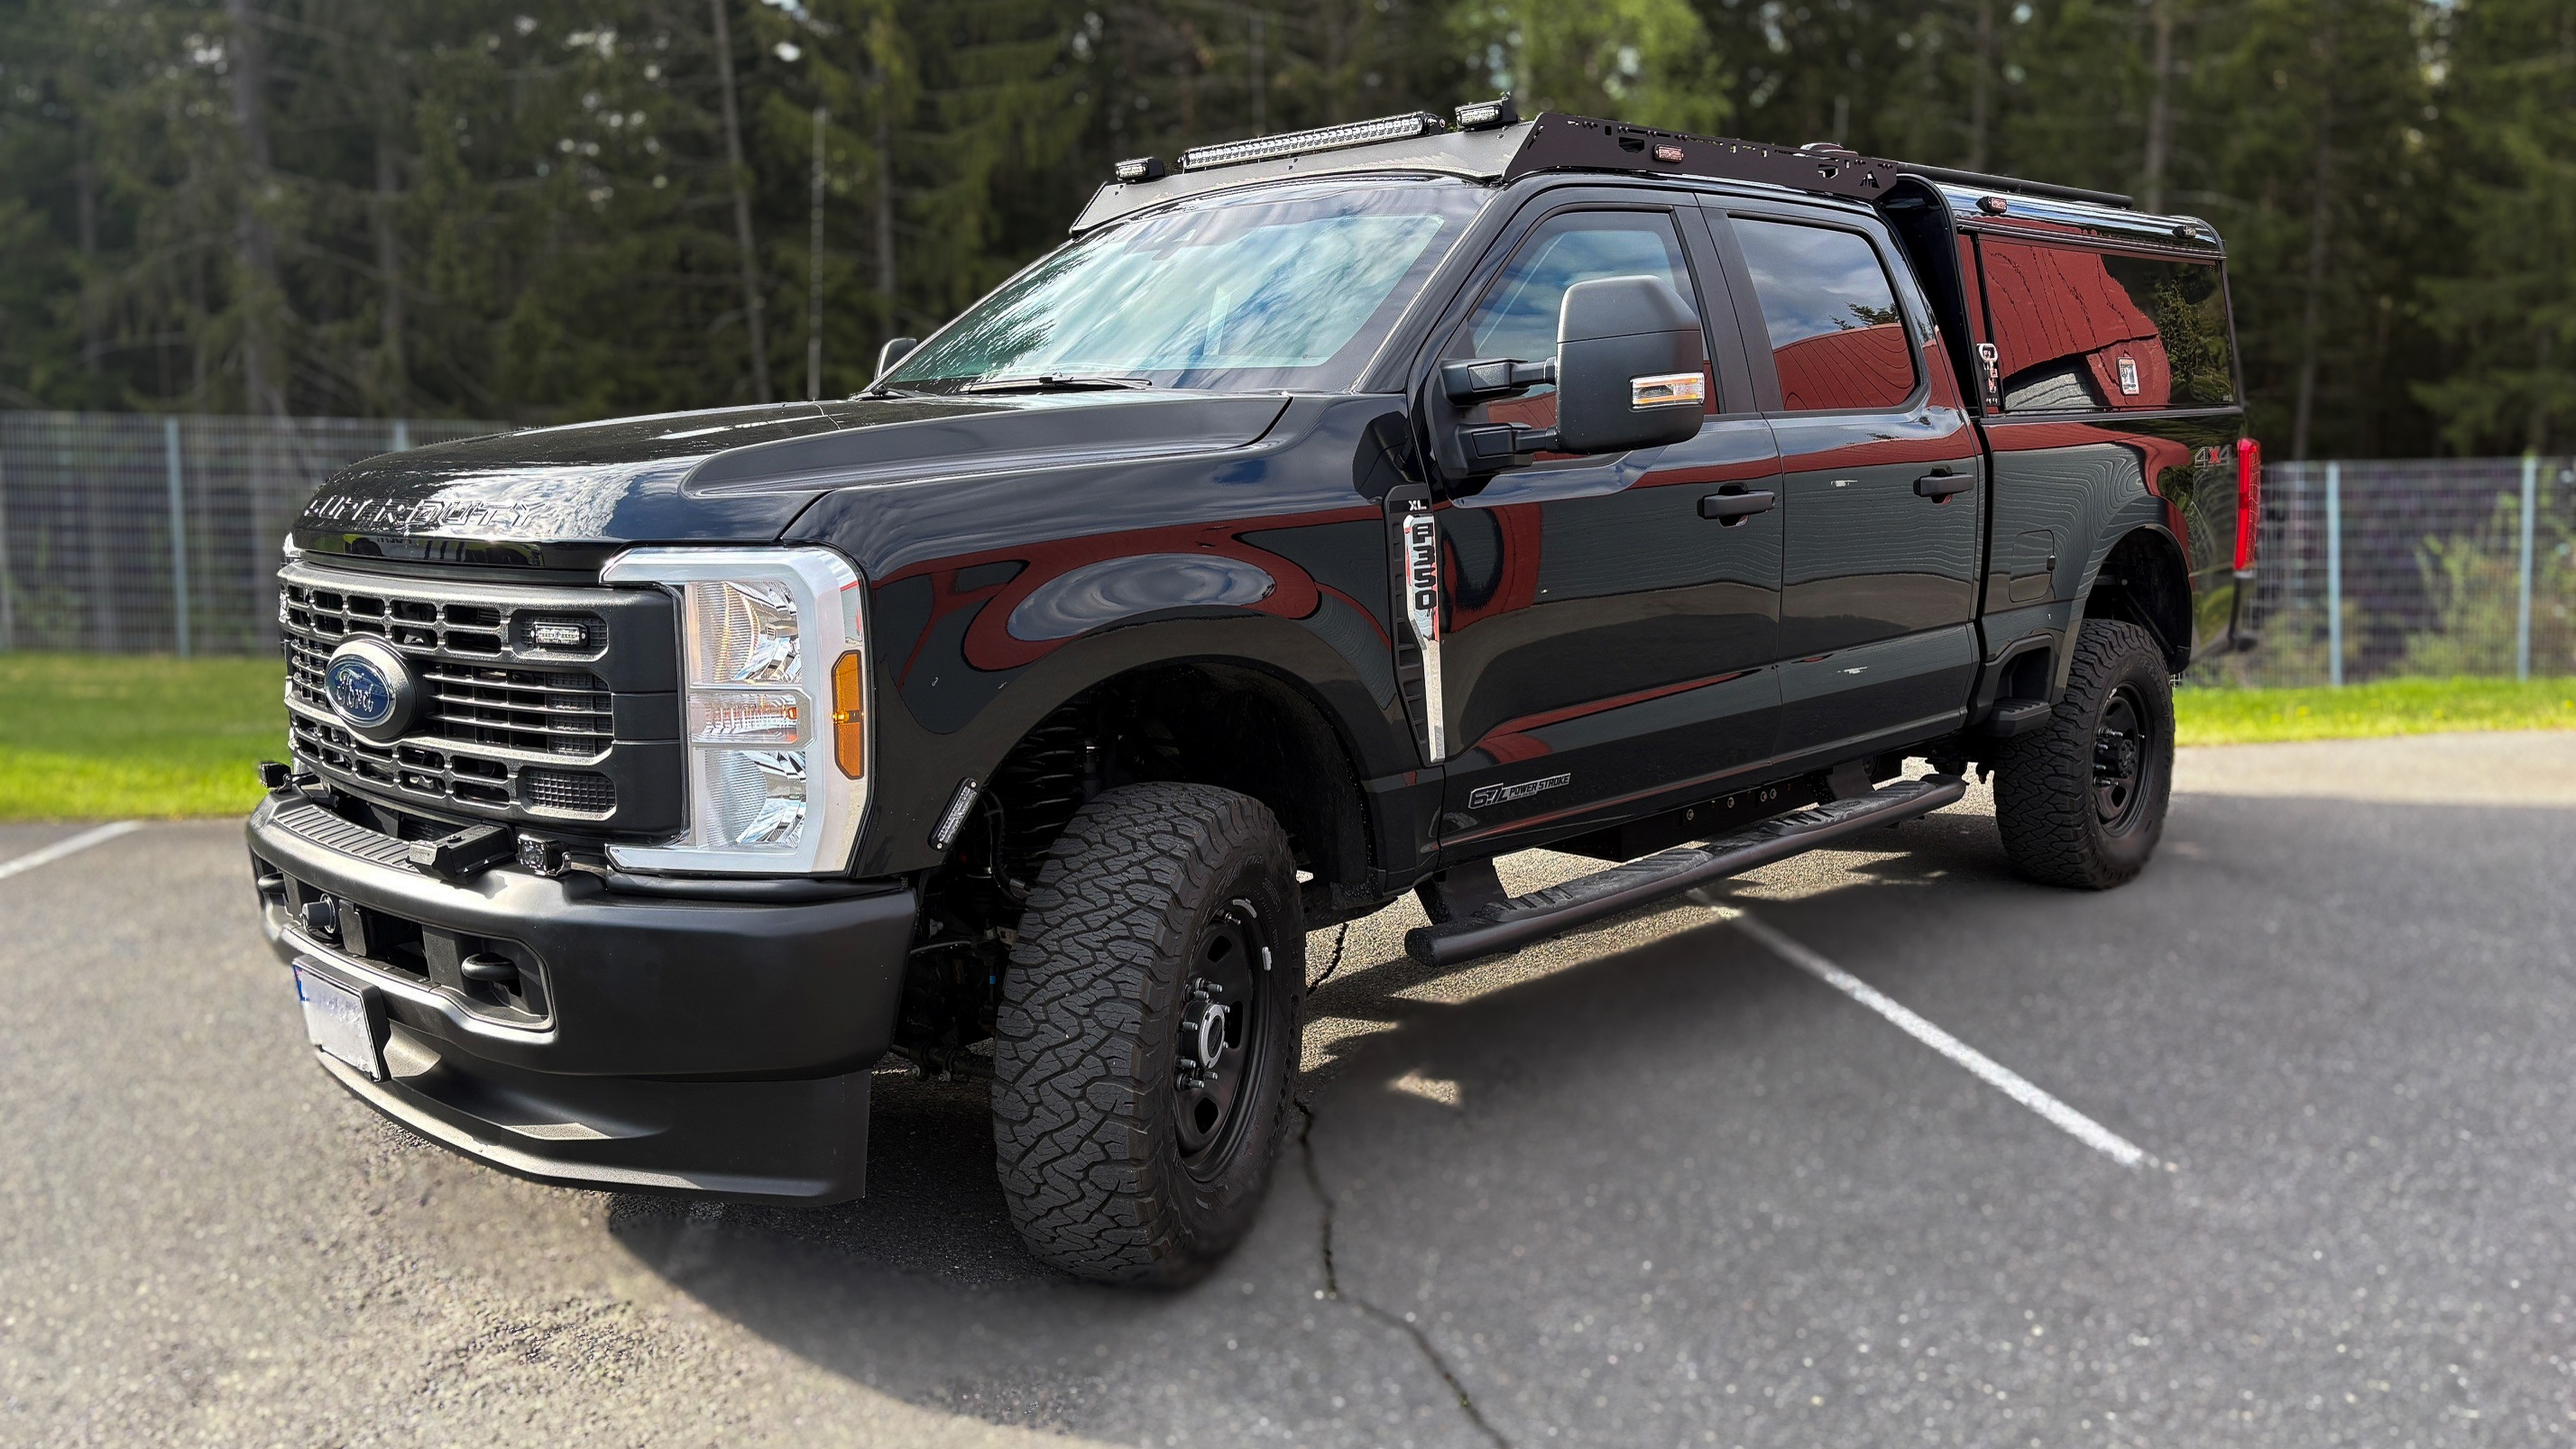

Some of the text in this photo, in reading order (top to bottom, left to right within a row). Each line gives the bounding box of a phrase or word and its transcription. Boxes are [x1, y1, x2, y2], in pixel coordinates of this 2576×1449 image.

[405, 499, 538, 527] DUTY
[1408, 500, 1427, 511] XL
[1412, 522, 1437, 610] F350
[336, 668, 374, 712] Ford
[1510, 782, 1537, 796] POWER
[1538, 775, 1569, 790] STROKE
